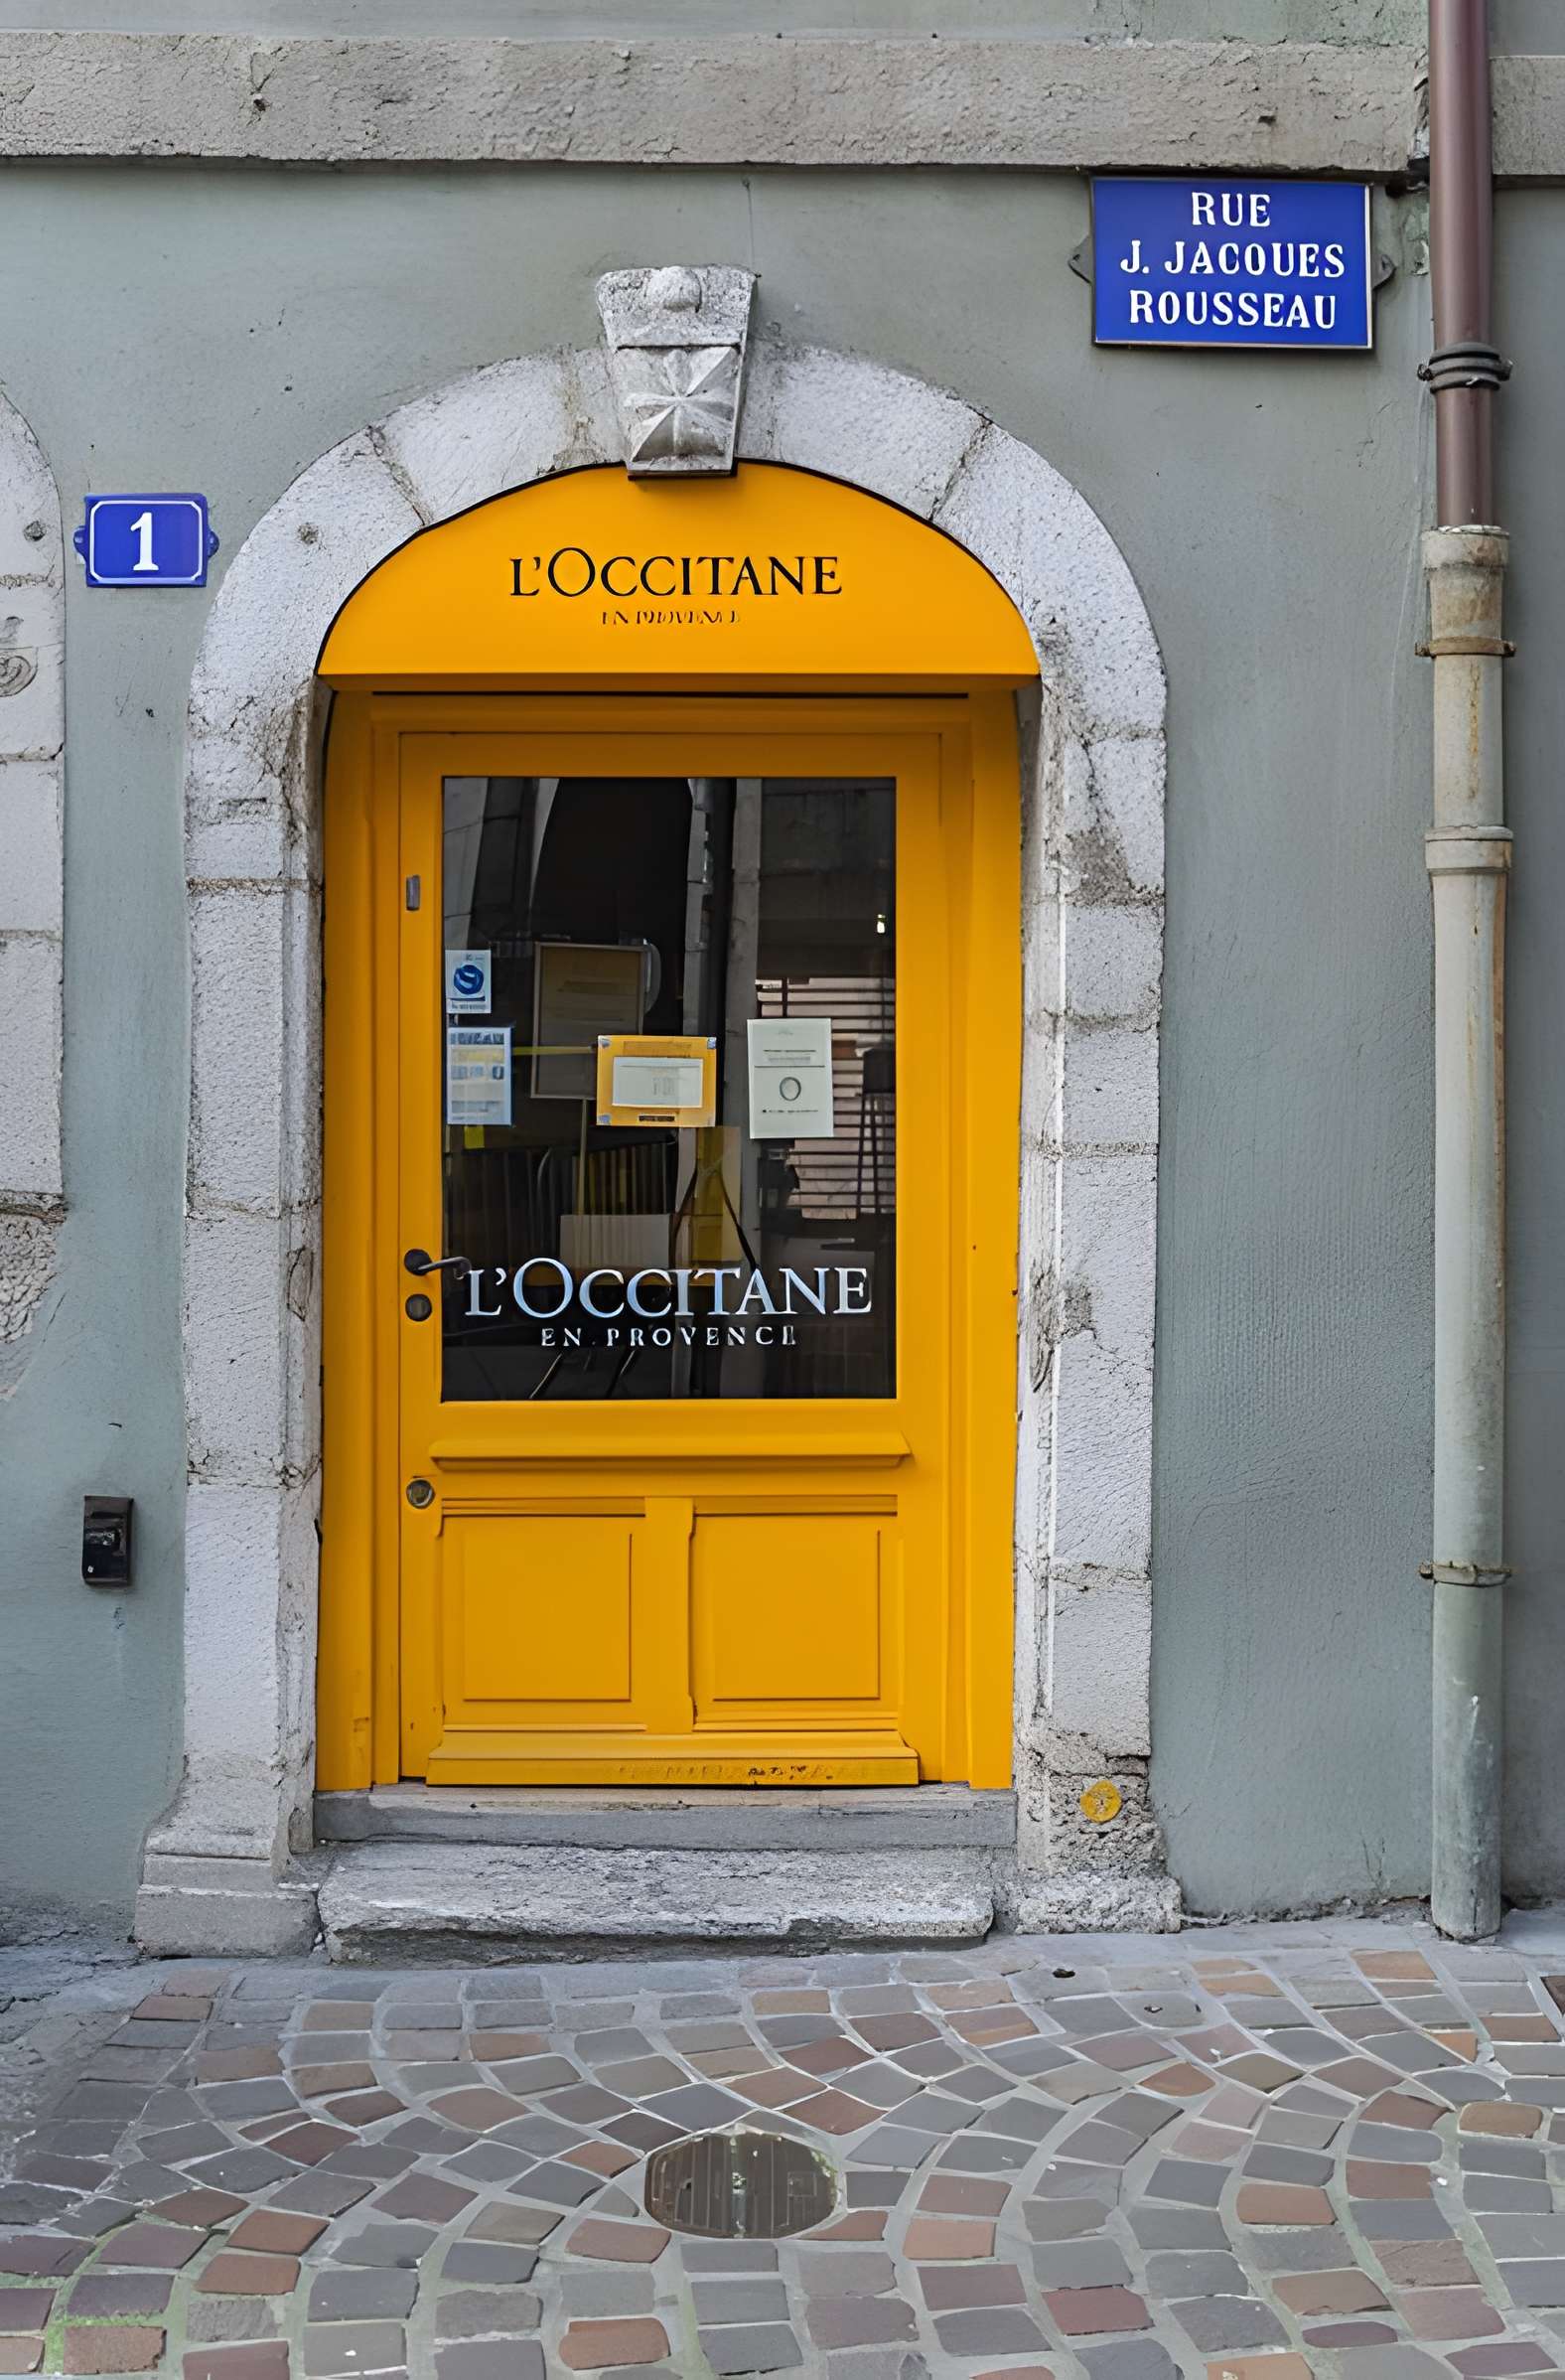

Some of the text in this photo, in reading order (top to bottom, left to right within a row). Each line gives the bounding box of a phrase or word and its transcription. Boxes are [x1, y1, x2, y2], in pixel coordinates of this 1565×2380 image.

[1192, 192, 1271, 227] RUE
[1120, 239, 1150, 274] J.
[1129, 289, 1336, 330] ROUSSEAU
[130, 512, 160, 571] 1
[509, 546, 843, 598] L'OCCITANE
[465, 1257, 872, 1319] L'OCCITANE
[541, 1327, 582, 1347] EN
